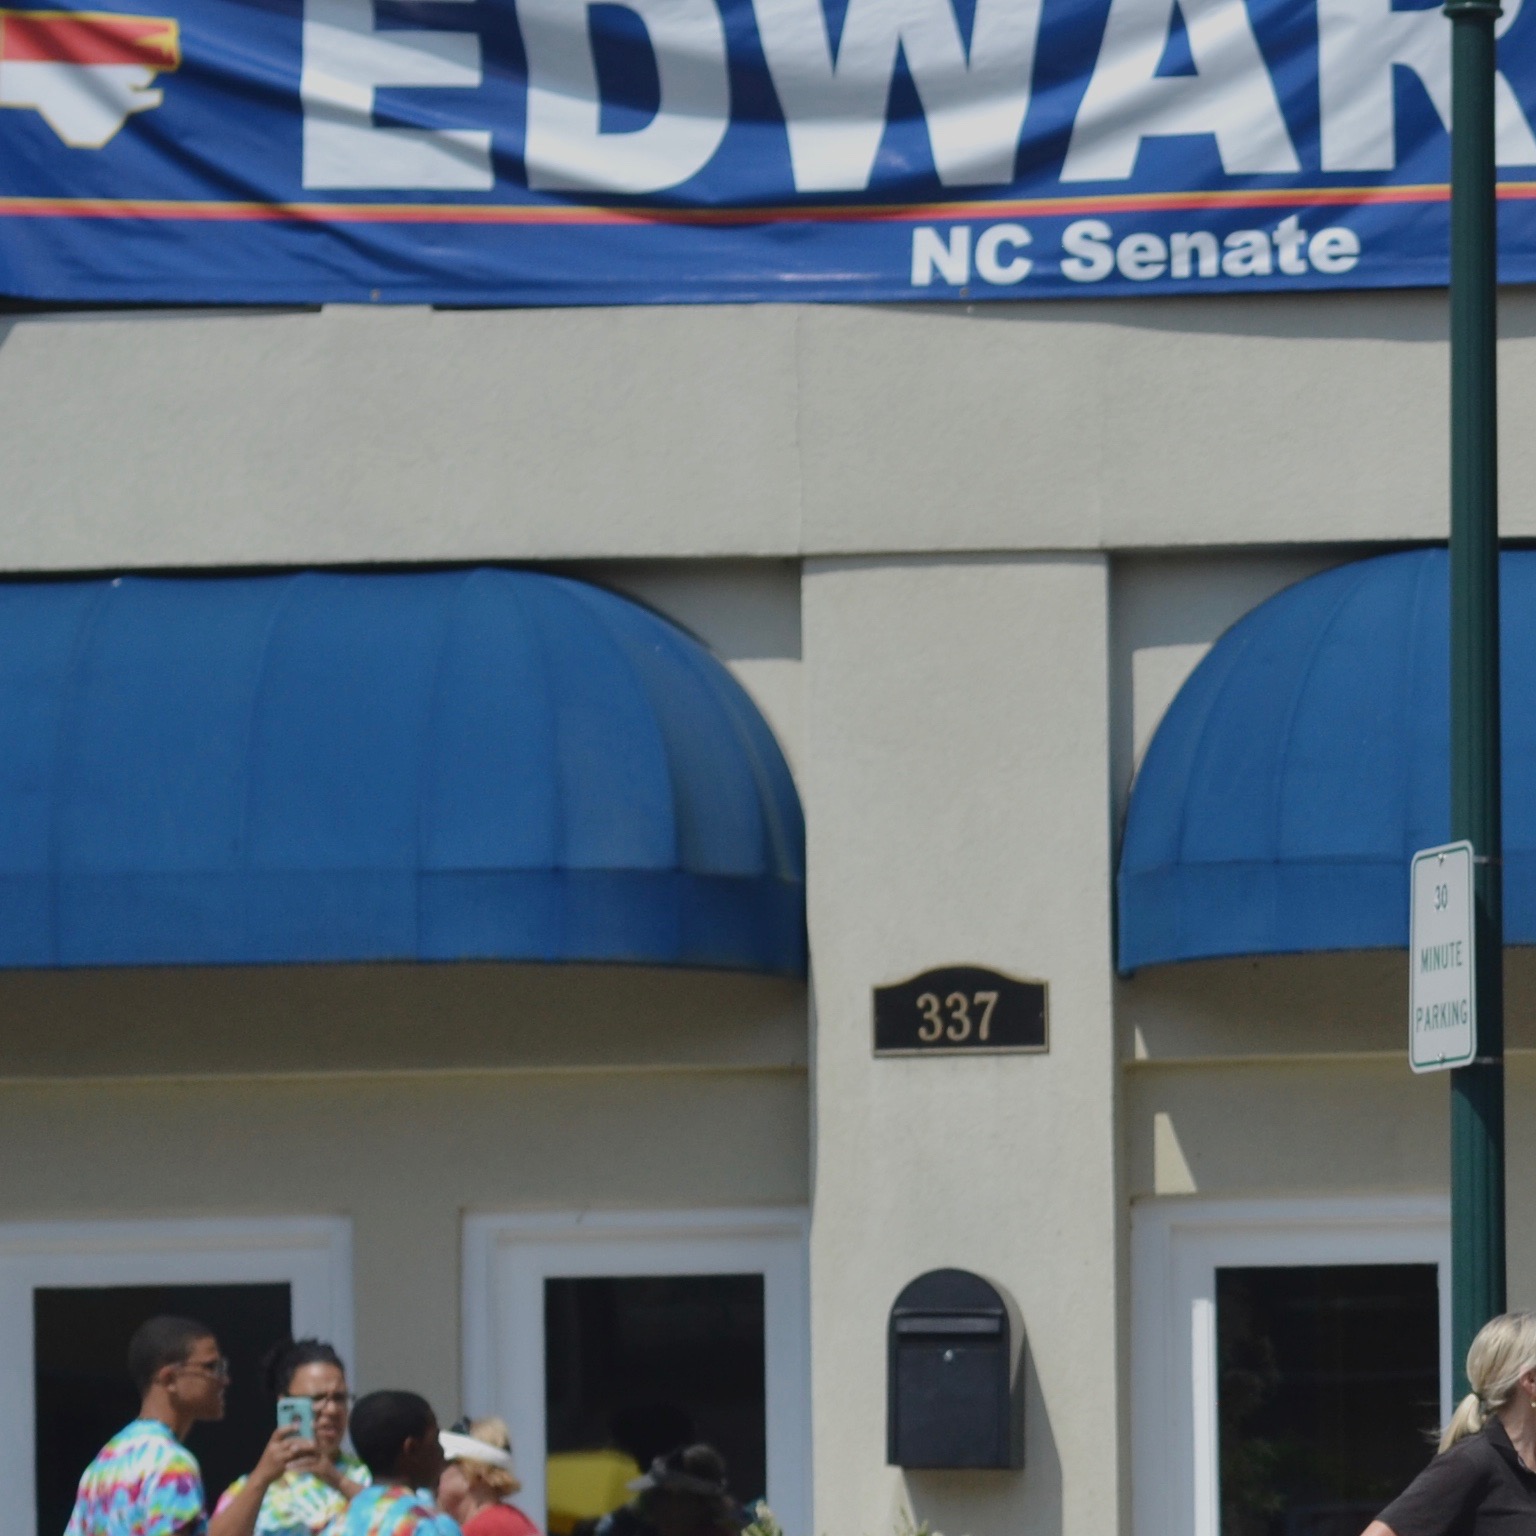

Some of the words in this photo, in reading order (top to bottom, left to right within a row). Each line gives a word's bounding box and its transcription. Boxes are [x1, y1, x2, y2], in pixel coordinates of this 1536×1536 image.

[910, 225, 1032, 287] NC
[1061, 214, 1361, 283] Senate
[1435, 884, 1449, 911] 30
[1420, 941, 1463, 974] MINUTE
[915, 991, 999, 1042] 337
[1416, 999, 1468, 1033] PARKING
